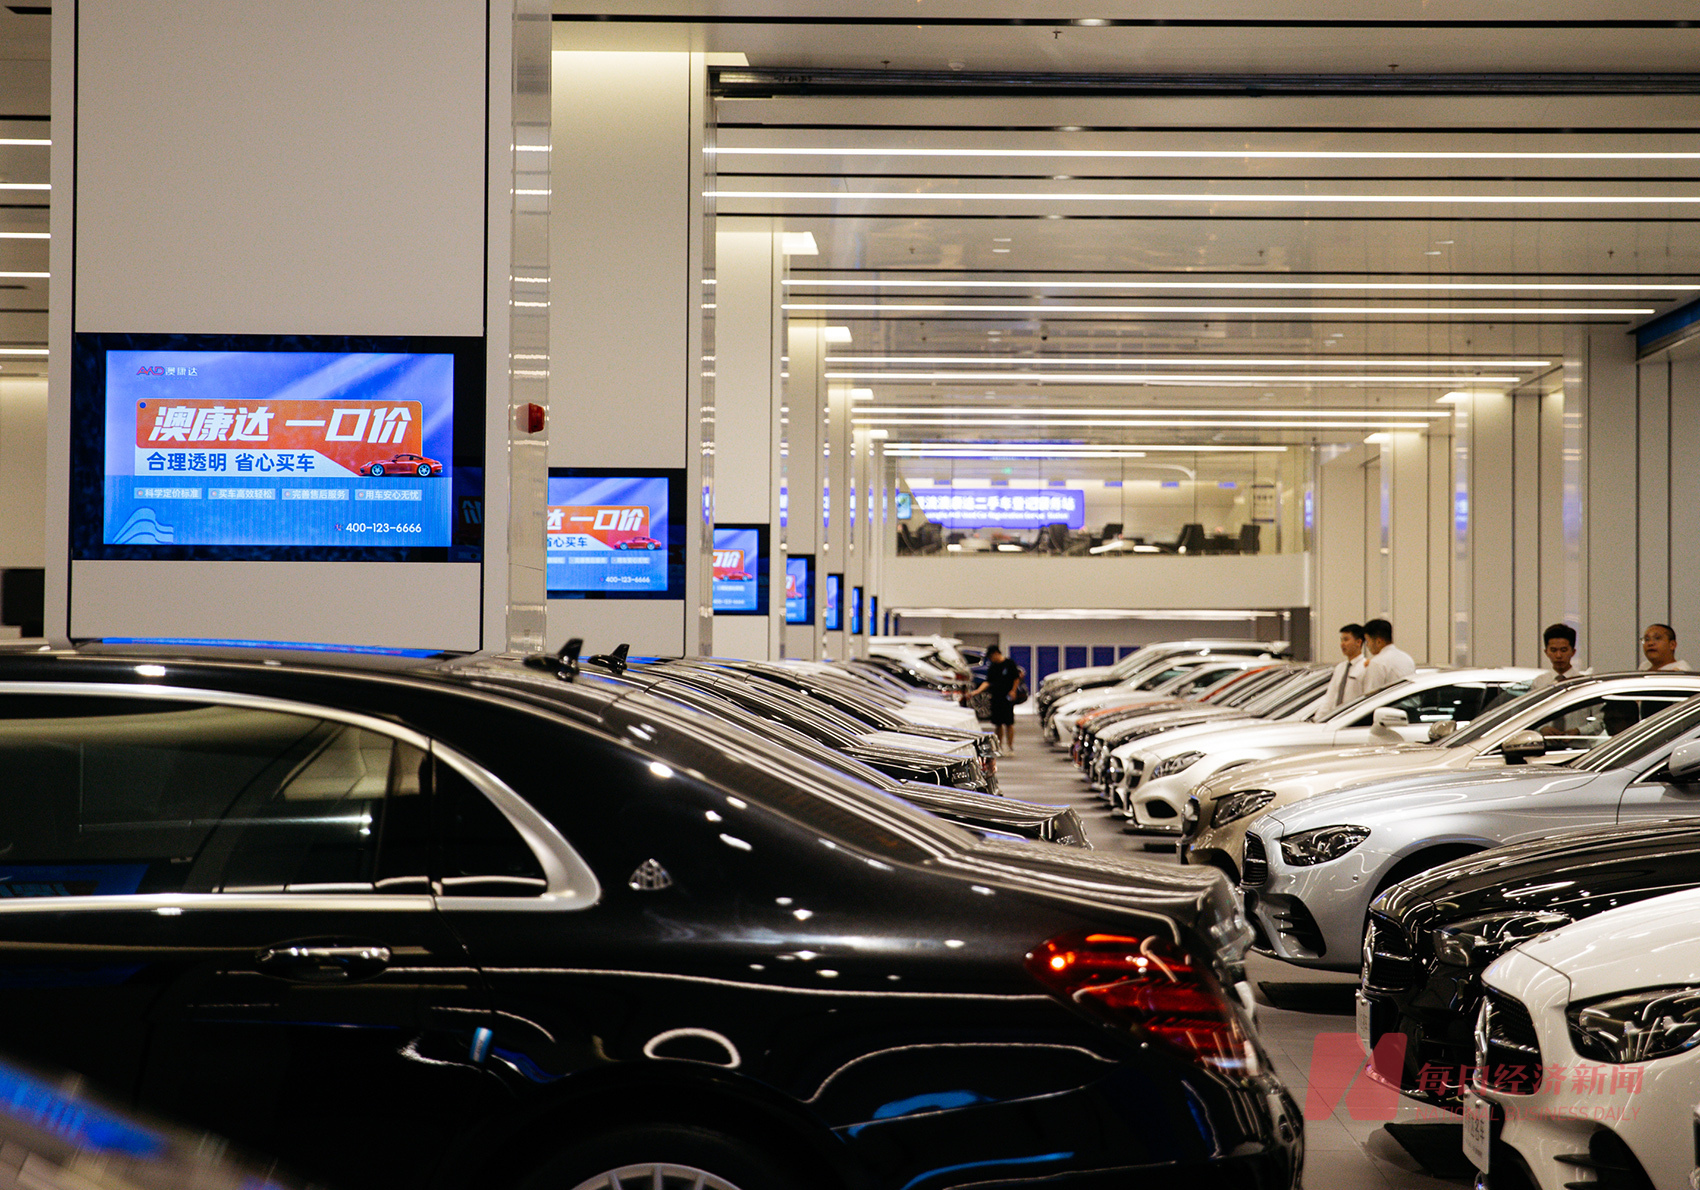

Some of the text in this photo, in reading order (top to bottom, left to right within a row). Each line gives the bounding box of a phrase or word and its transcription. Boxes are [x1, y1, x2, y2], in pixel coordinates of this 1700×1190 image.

[165, 366, 198, 376] 澳康达
[148, 406, 412, 444] 澳康达 一口价
[146, 451, 315, 473] 合理透明 省心买车
[145, 488, 419, 500] 科学定价标准 买车高效轻松 完善售后服务 用车安心无忧
[345, 522, 422, 533] 400-123-6666
[570, 508, 645, 531] 一口价
